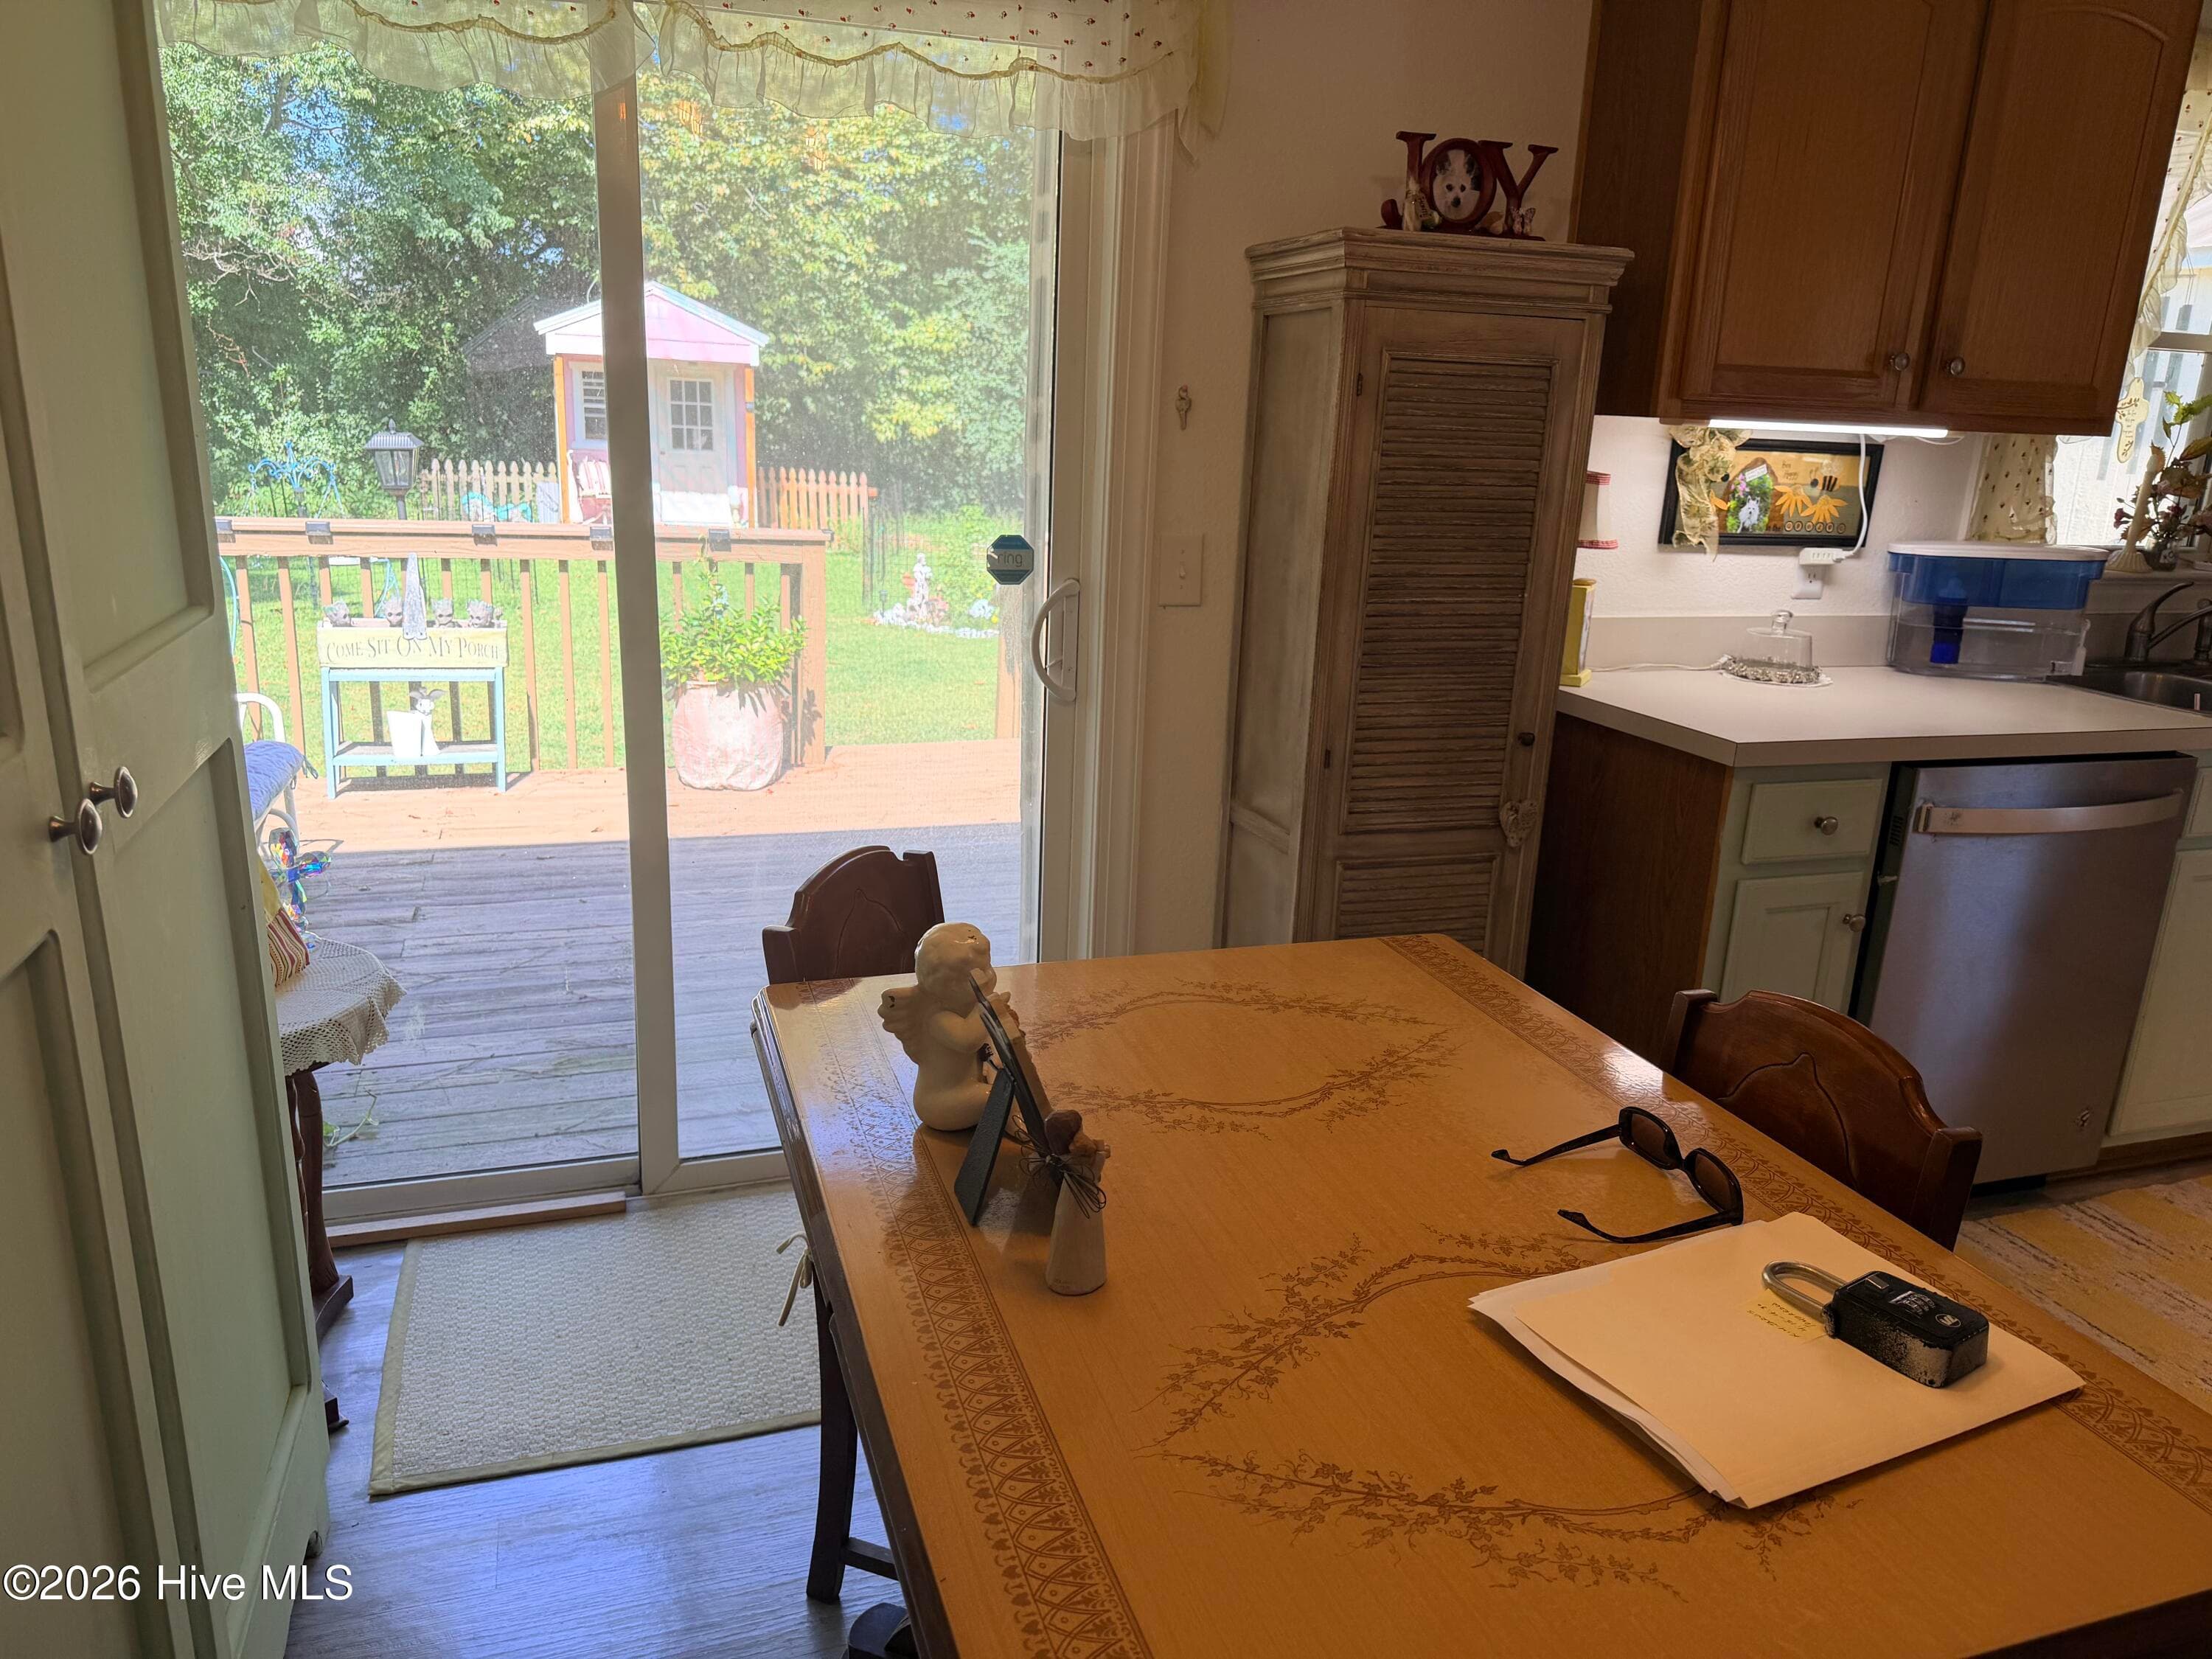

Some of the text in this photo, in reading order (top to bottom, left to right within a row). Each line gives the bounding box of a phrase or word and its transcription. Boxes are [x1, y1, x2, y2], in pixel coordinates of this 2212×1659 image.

[1381, 131, 1559, 227] JOY
[997, 552, 1023, 568] ring
[327, 636, 499, 662] COME SIT ON MY PORCH
